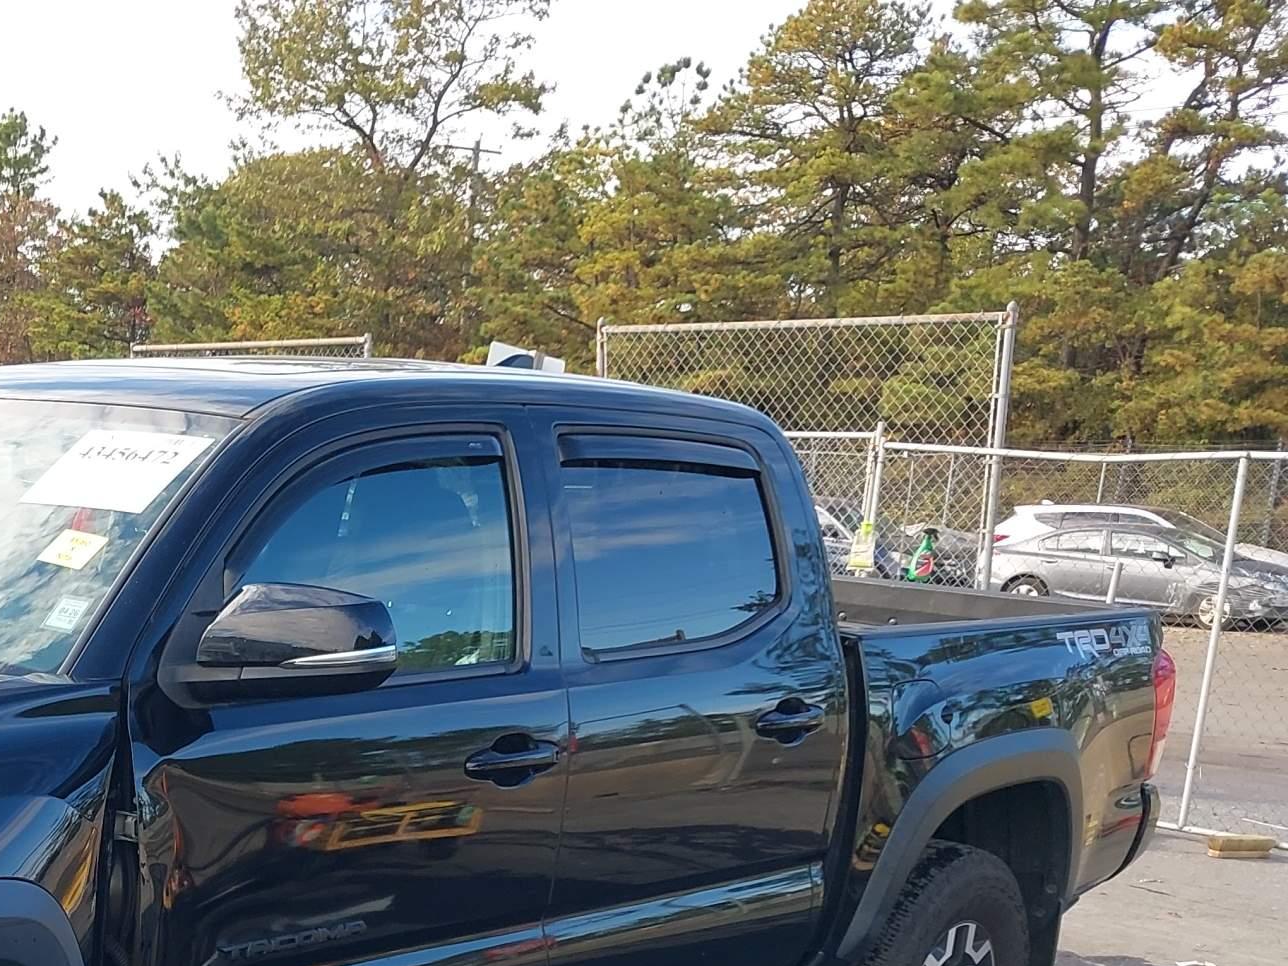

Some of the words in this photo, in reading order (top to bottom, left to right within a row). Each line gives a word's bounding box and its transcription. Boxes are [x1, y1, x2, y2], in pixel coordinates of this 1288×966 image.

[80, 446, 179, 464] 43456472
[1056, 628, 1110, 660] TRD
[217, 920, 367, 958] TACOMA
